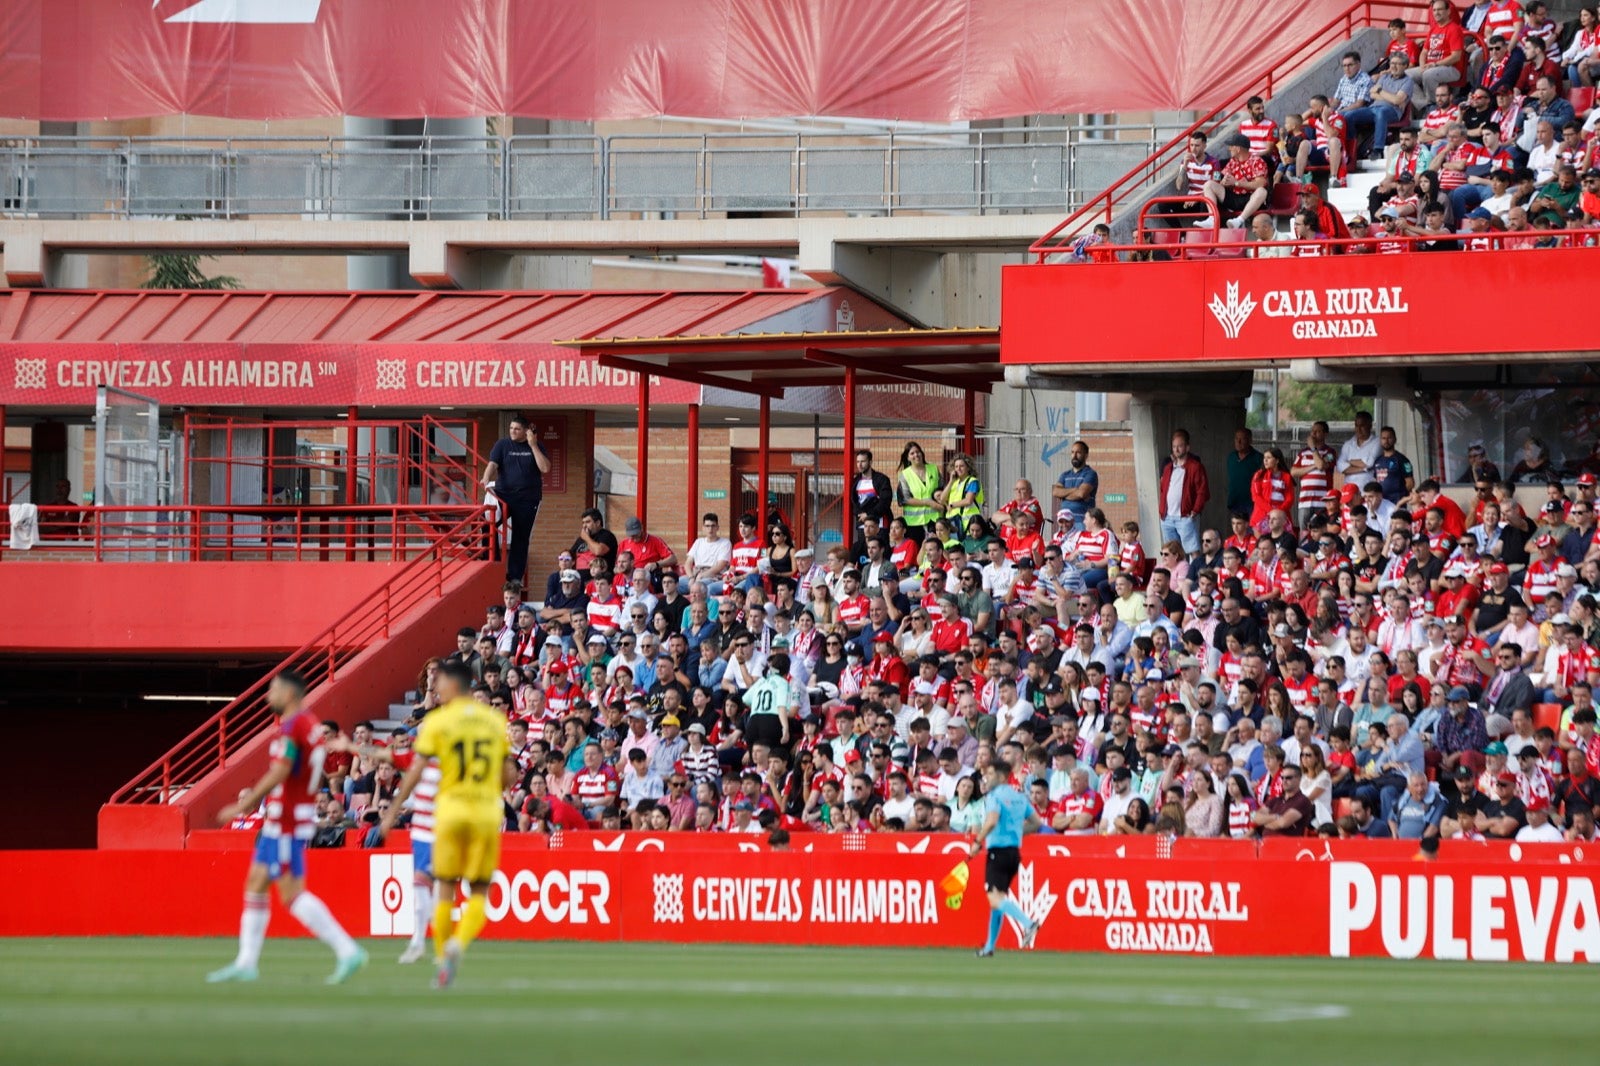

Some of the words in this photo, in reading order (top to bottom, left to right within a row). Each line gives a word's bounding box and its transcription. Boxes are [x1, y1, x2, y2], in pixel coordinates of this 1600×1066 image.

[1262, 289, 1321, 319] CAJA
[1325, 286, 1409, 315] RURAL
[1292, 318, 1378, 340] GRANADA
[57, 360, 173, 388] CERVEZAS
[181, 360, 315, 388] ALHAMBRA
[318, 361, 337, 376] SIN
[416, 360, 526, 388] CERVEZAS
[1046, 406, 1070, 433] WC
[755, 689, 773, 712] 10
[453, 739, 492, 783] 15
[692, 876, 803, 923] CERVEZAS
[810, 878, 939, 924] ALHAMBRA
[1066, 878, 1137, 920] CAJA
[1146, 880, 1249, 921] RURAL
[1329, 861, 1600, 964] PULEVA
[1105, 921, 1213, 953] GRANADA
